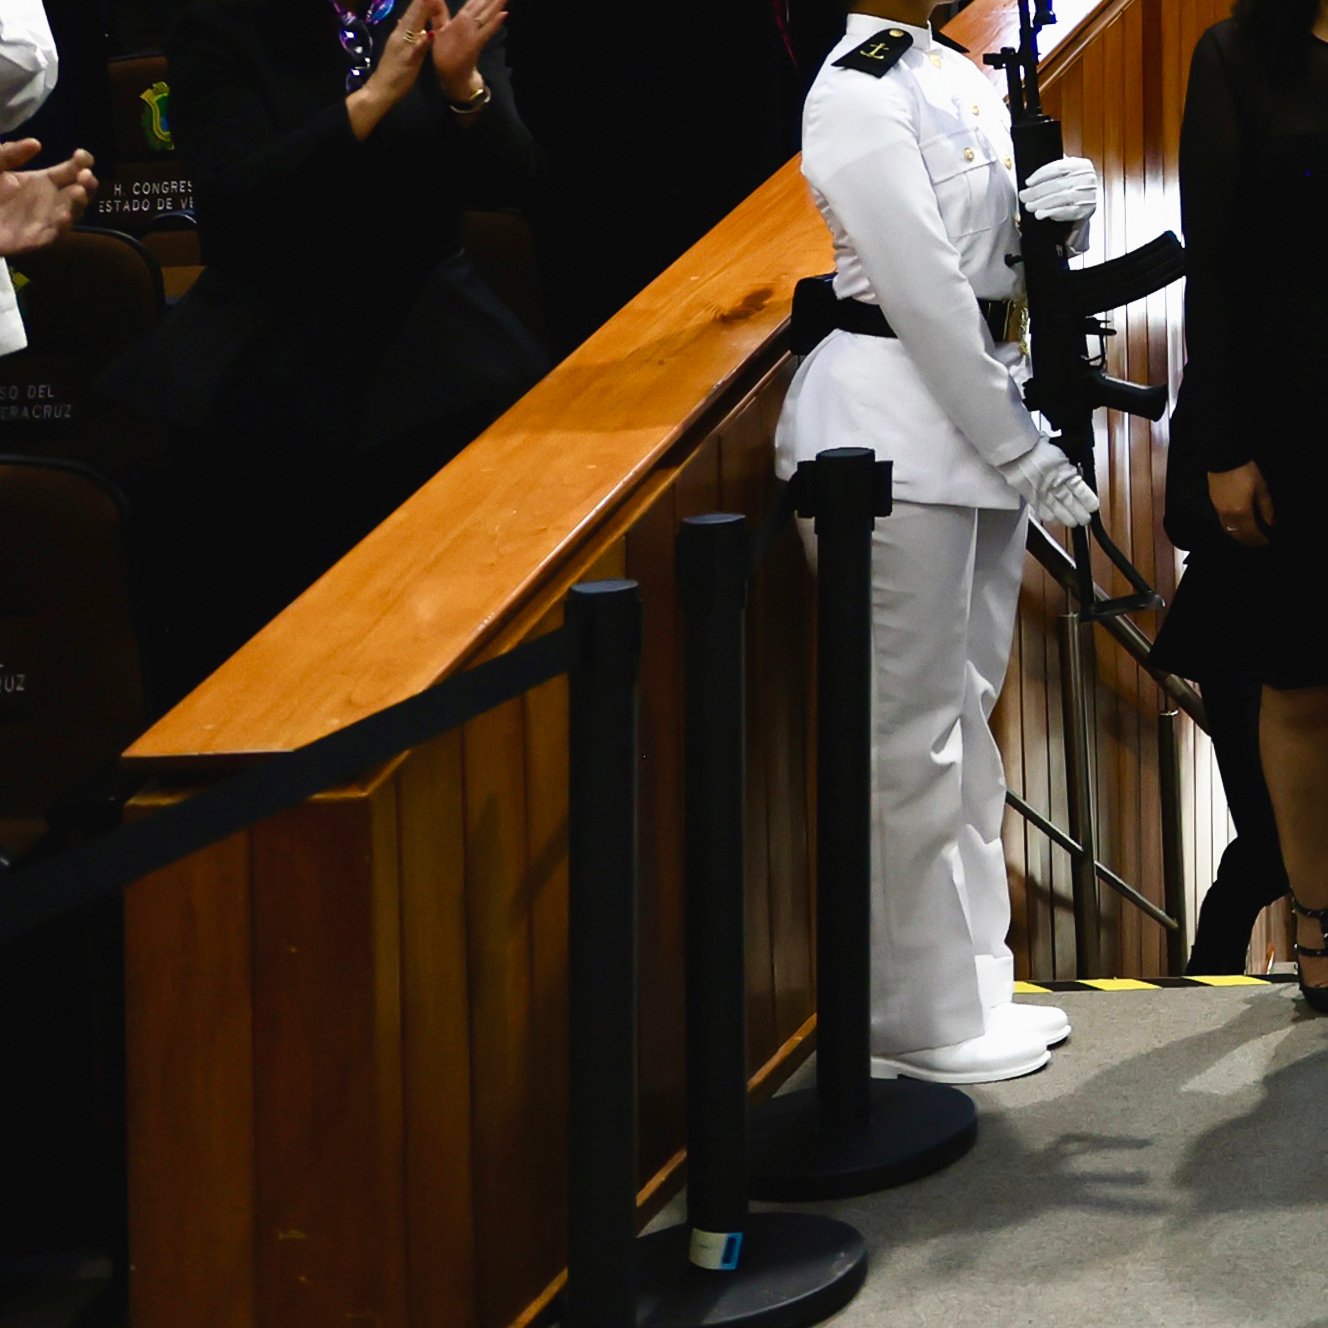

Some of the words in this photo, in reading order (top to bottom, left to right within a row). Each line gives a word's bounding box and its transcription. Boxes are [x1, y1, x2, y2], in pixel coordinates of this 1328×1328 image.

[98, 198, 151, 213] ESTADO
[157, 197, 173, 211] DE
[27, 384, 55, 399] DEL
[0, 673, 26, 693] UZ
